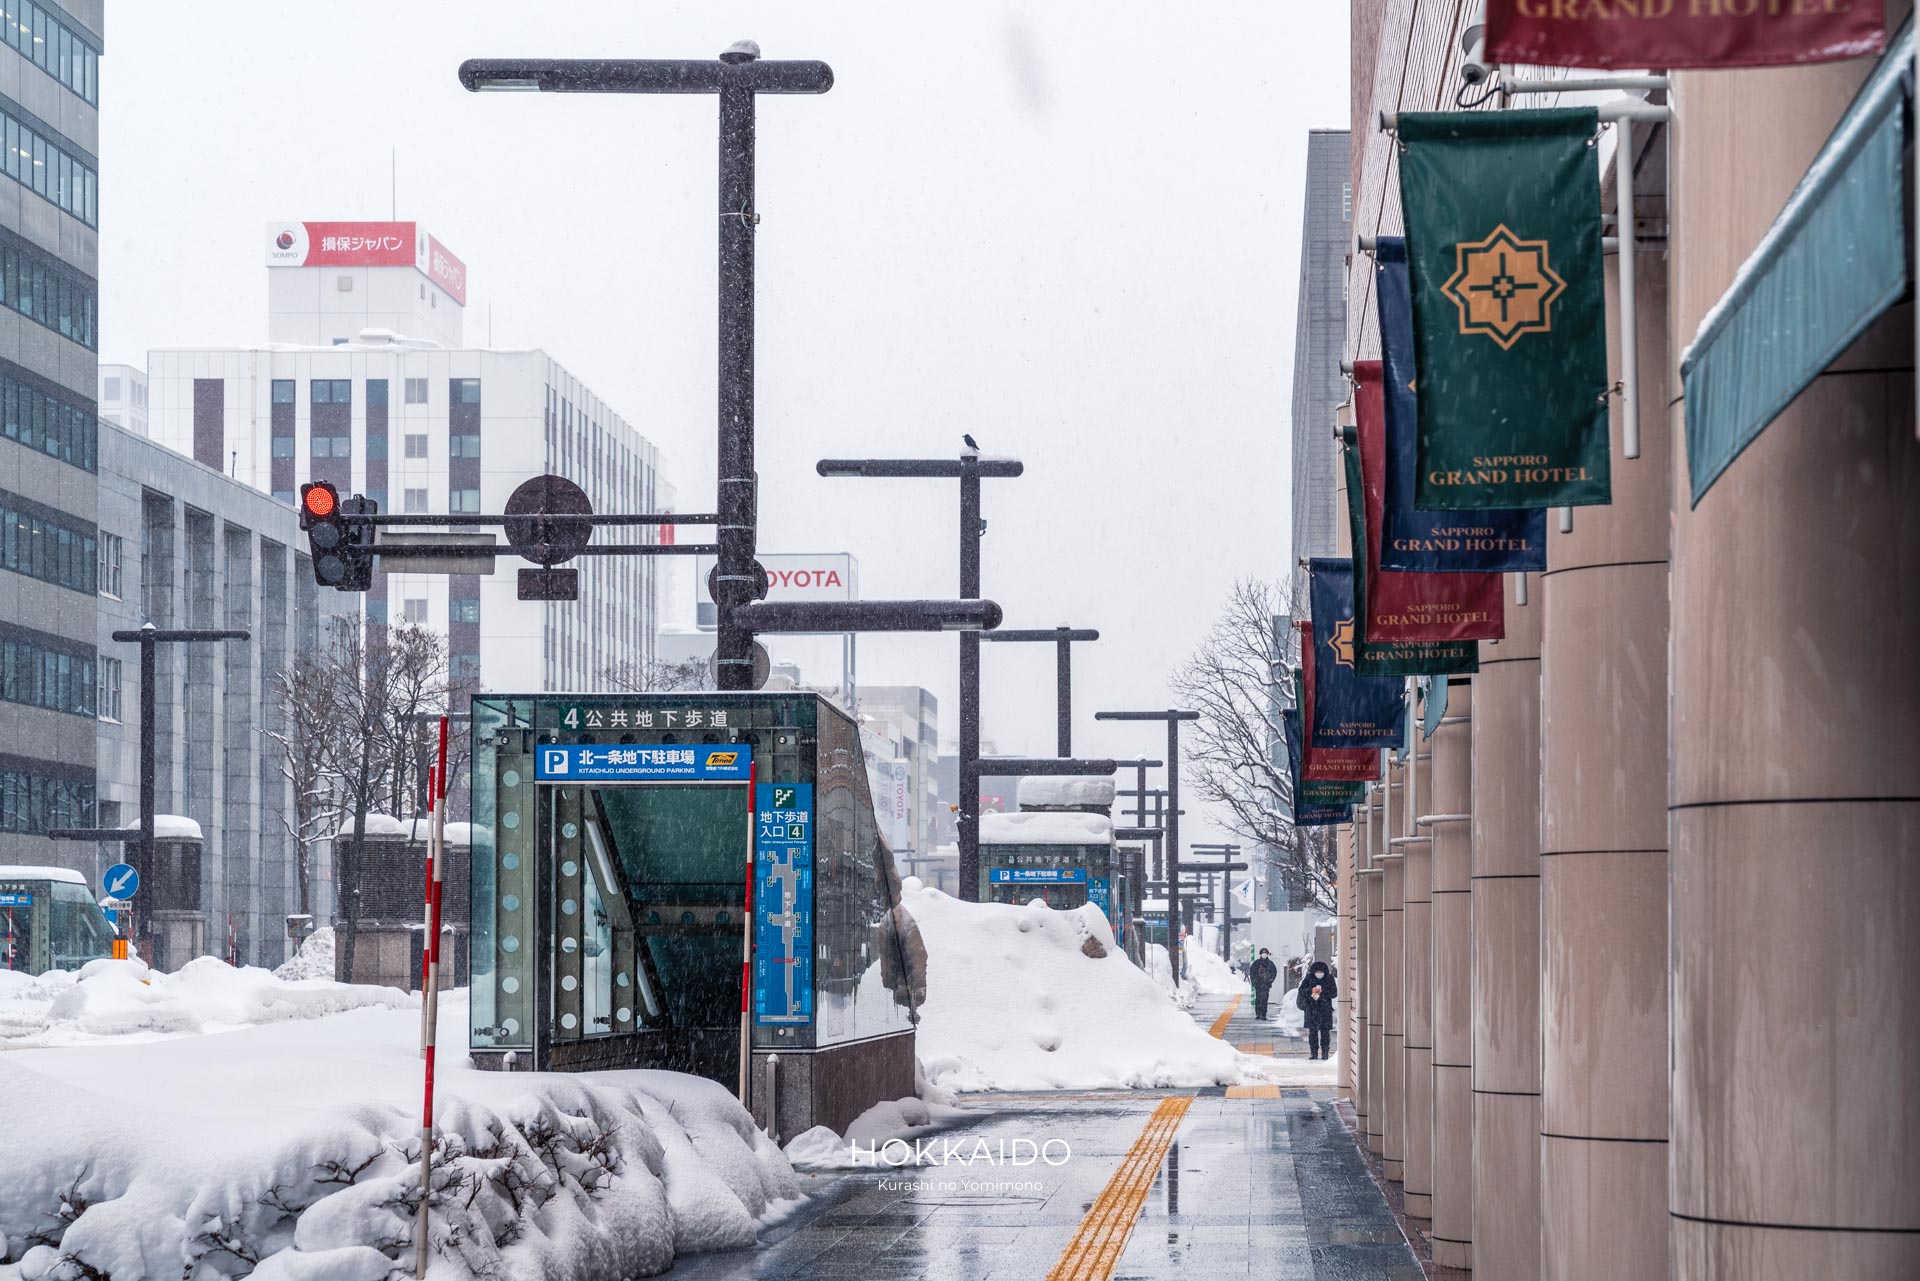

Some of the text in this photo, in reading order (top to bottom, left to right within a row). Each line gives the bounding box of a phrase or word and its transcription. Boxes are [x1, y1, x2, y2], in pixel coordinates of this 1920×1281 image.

[1516, 0, 1672, 19] GRAND
[322, 237, 403, 252] 損保ジャパン
[1473, 455, 1548, 467] SAPPORO
[1429, 467, 1594, 486] GRAND HOTEL
[1431, 527, 1494, 536] SAPPORO
[1393, 539, 1533, 551] GRAND HOTEL
[765, 570, 842, 588] OYOTA
[1407, 603, 1460, 613] SAPPORO
[1376, 612, 1493, 625] GRAND HOTEL
[1392, 641, 1440, 649] SAPPORO
[1364, 648, 1468, 660] GRAND HOTEL
[564, 708, 728, 729] 4 公共地下歩道
[1319, 728, 1397, 737] GRAND HOTEL
[578, 750, 695, 765] 北一条地下駐車場
[760, 811, 809, 824] 地下歩道
[760, 826, 800, 838] 入口 4
